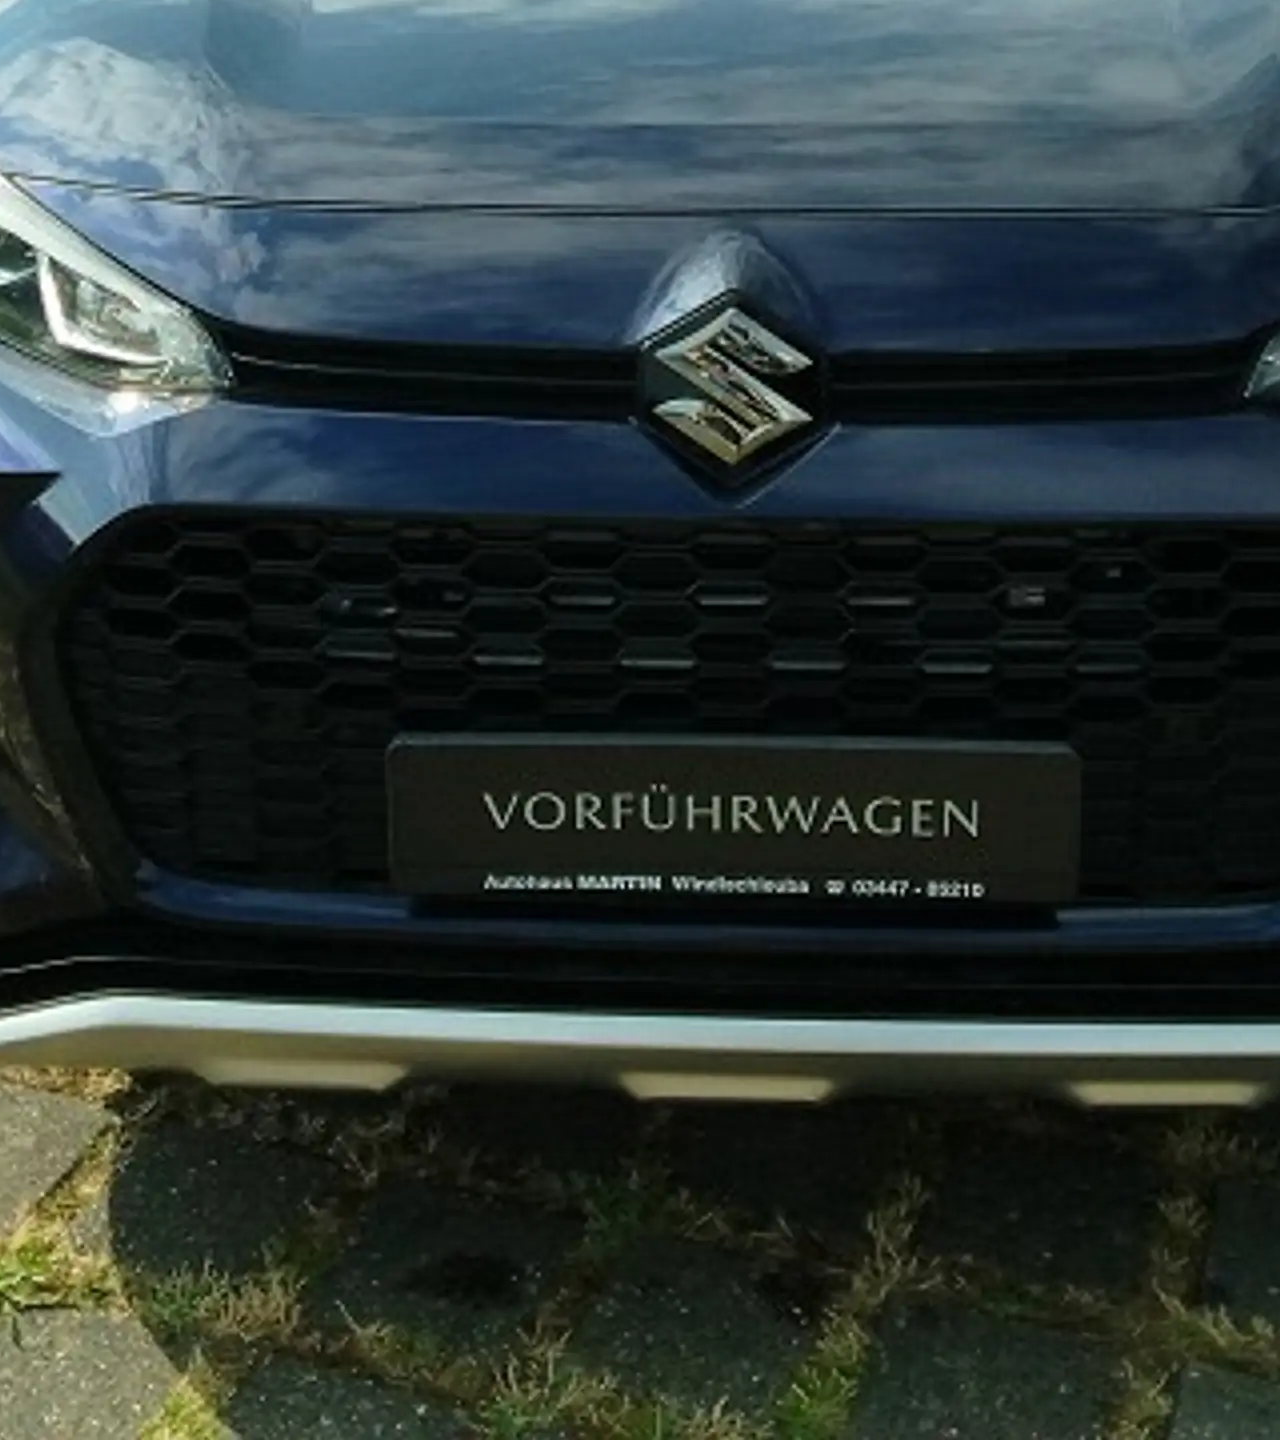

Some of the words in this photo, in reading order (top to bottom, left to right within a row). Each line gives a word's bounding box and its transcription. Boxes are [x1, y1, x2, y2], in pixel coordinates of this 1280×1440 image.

[483, 783, 980, 838] VORFÜHRWAGEN
[483, 873, 573, 890] Autohaus
[576, 874, 662, 891] MARTIN
[851, 879, 910, 897] 03447
